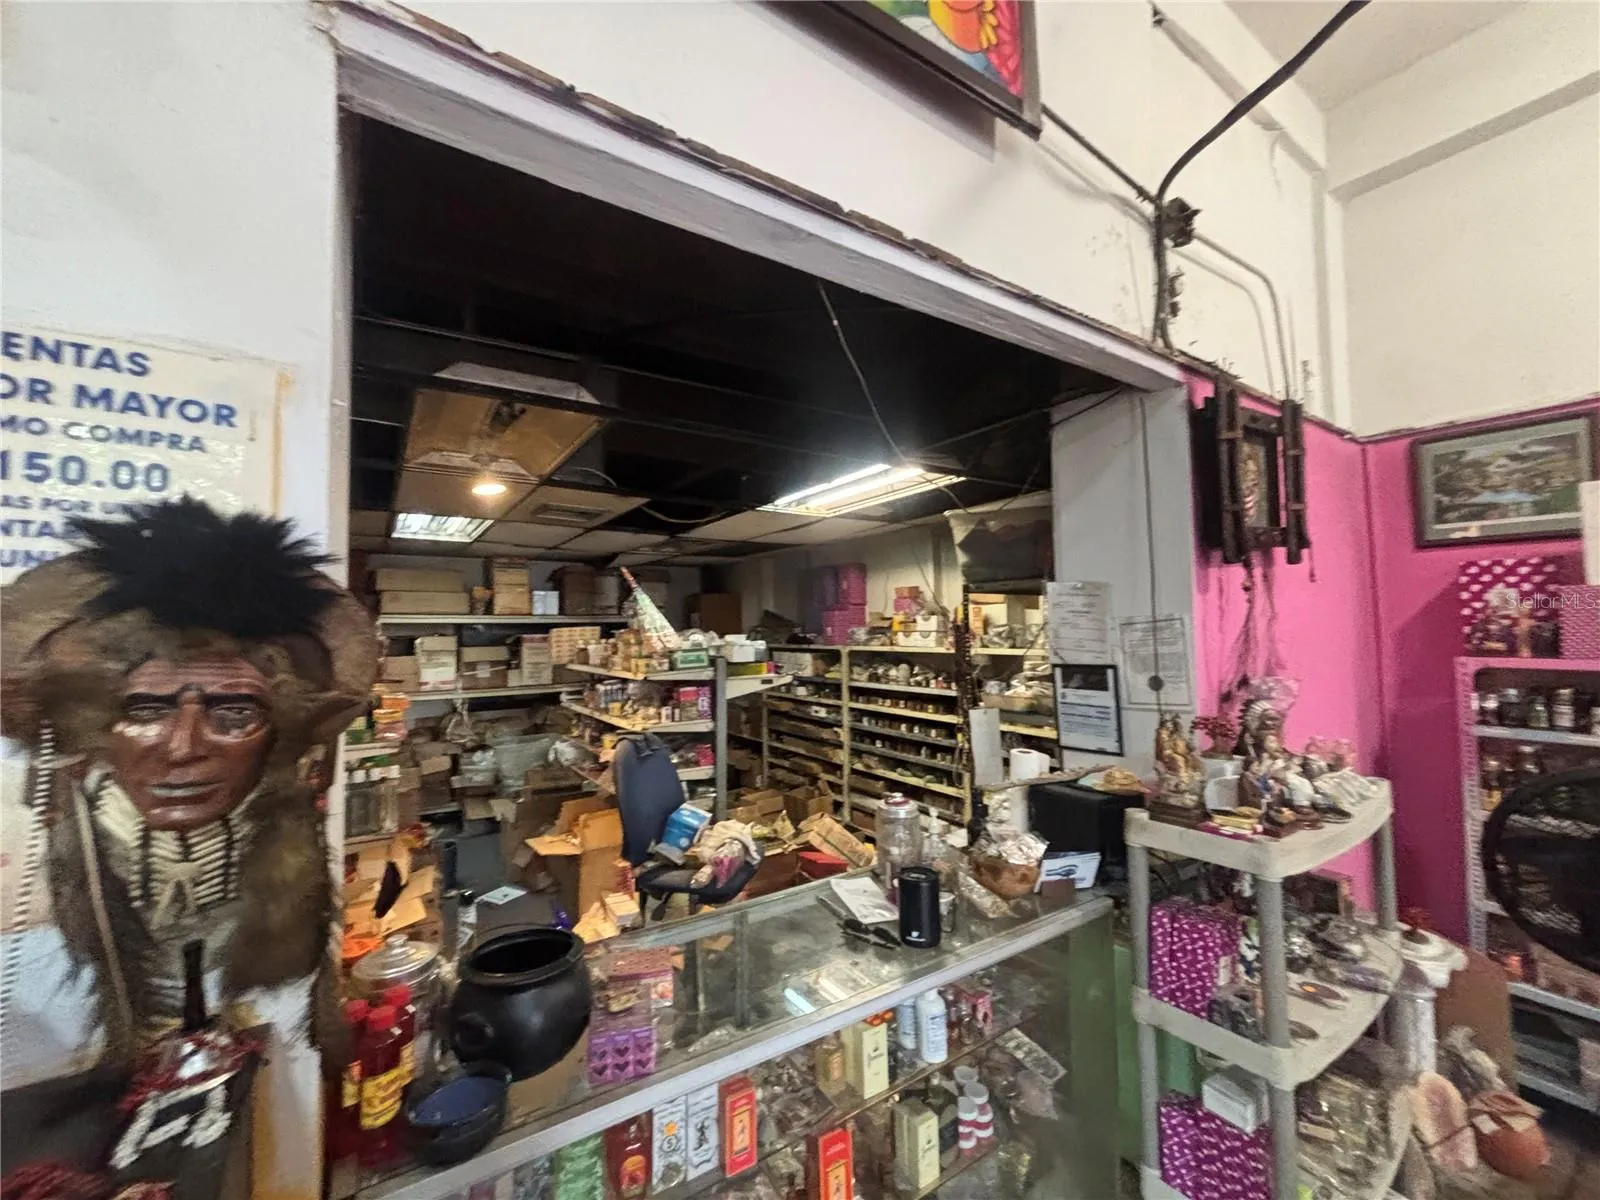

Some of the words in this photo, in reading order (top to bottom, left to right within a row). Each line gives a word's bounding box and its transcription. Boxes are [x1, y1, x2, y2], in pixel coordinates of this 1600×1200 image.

[1, 331, 152, 377] ENTAS
[72, 384, 239, 428] MAYOR
[62, 421, 208, 454] COMPRA
